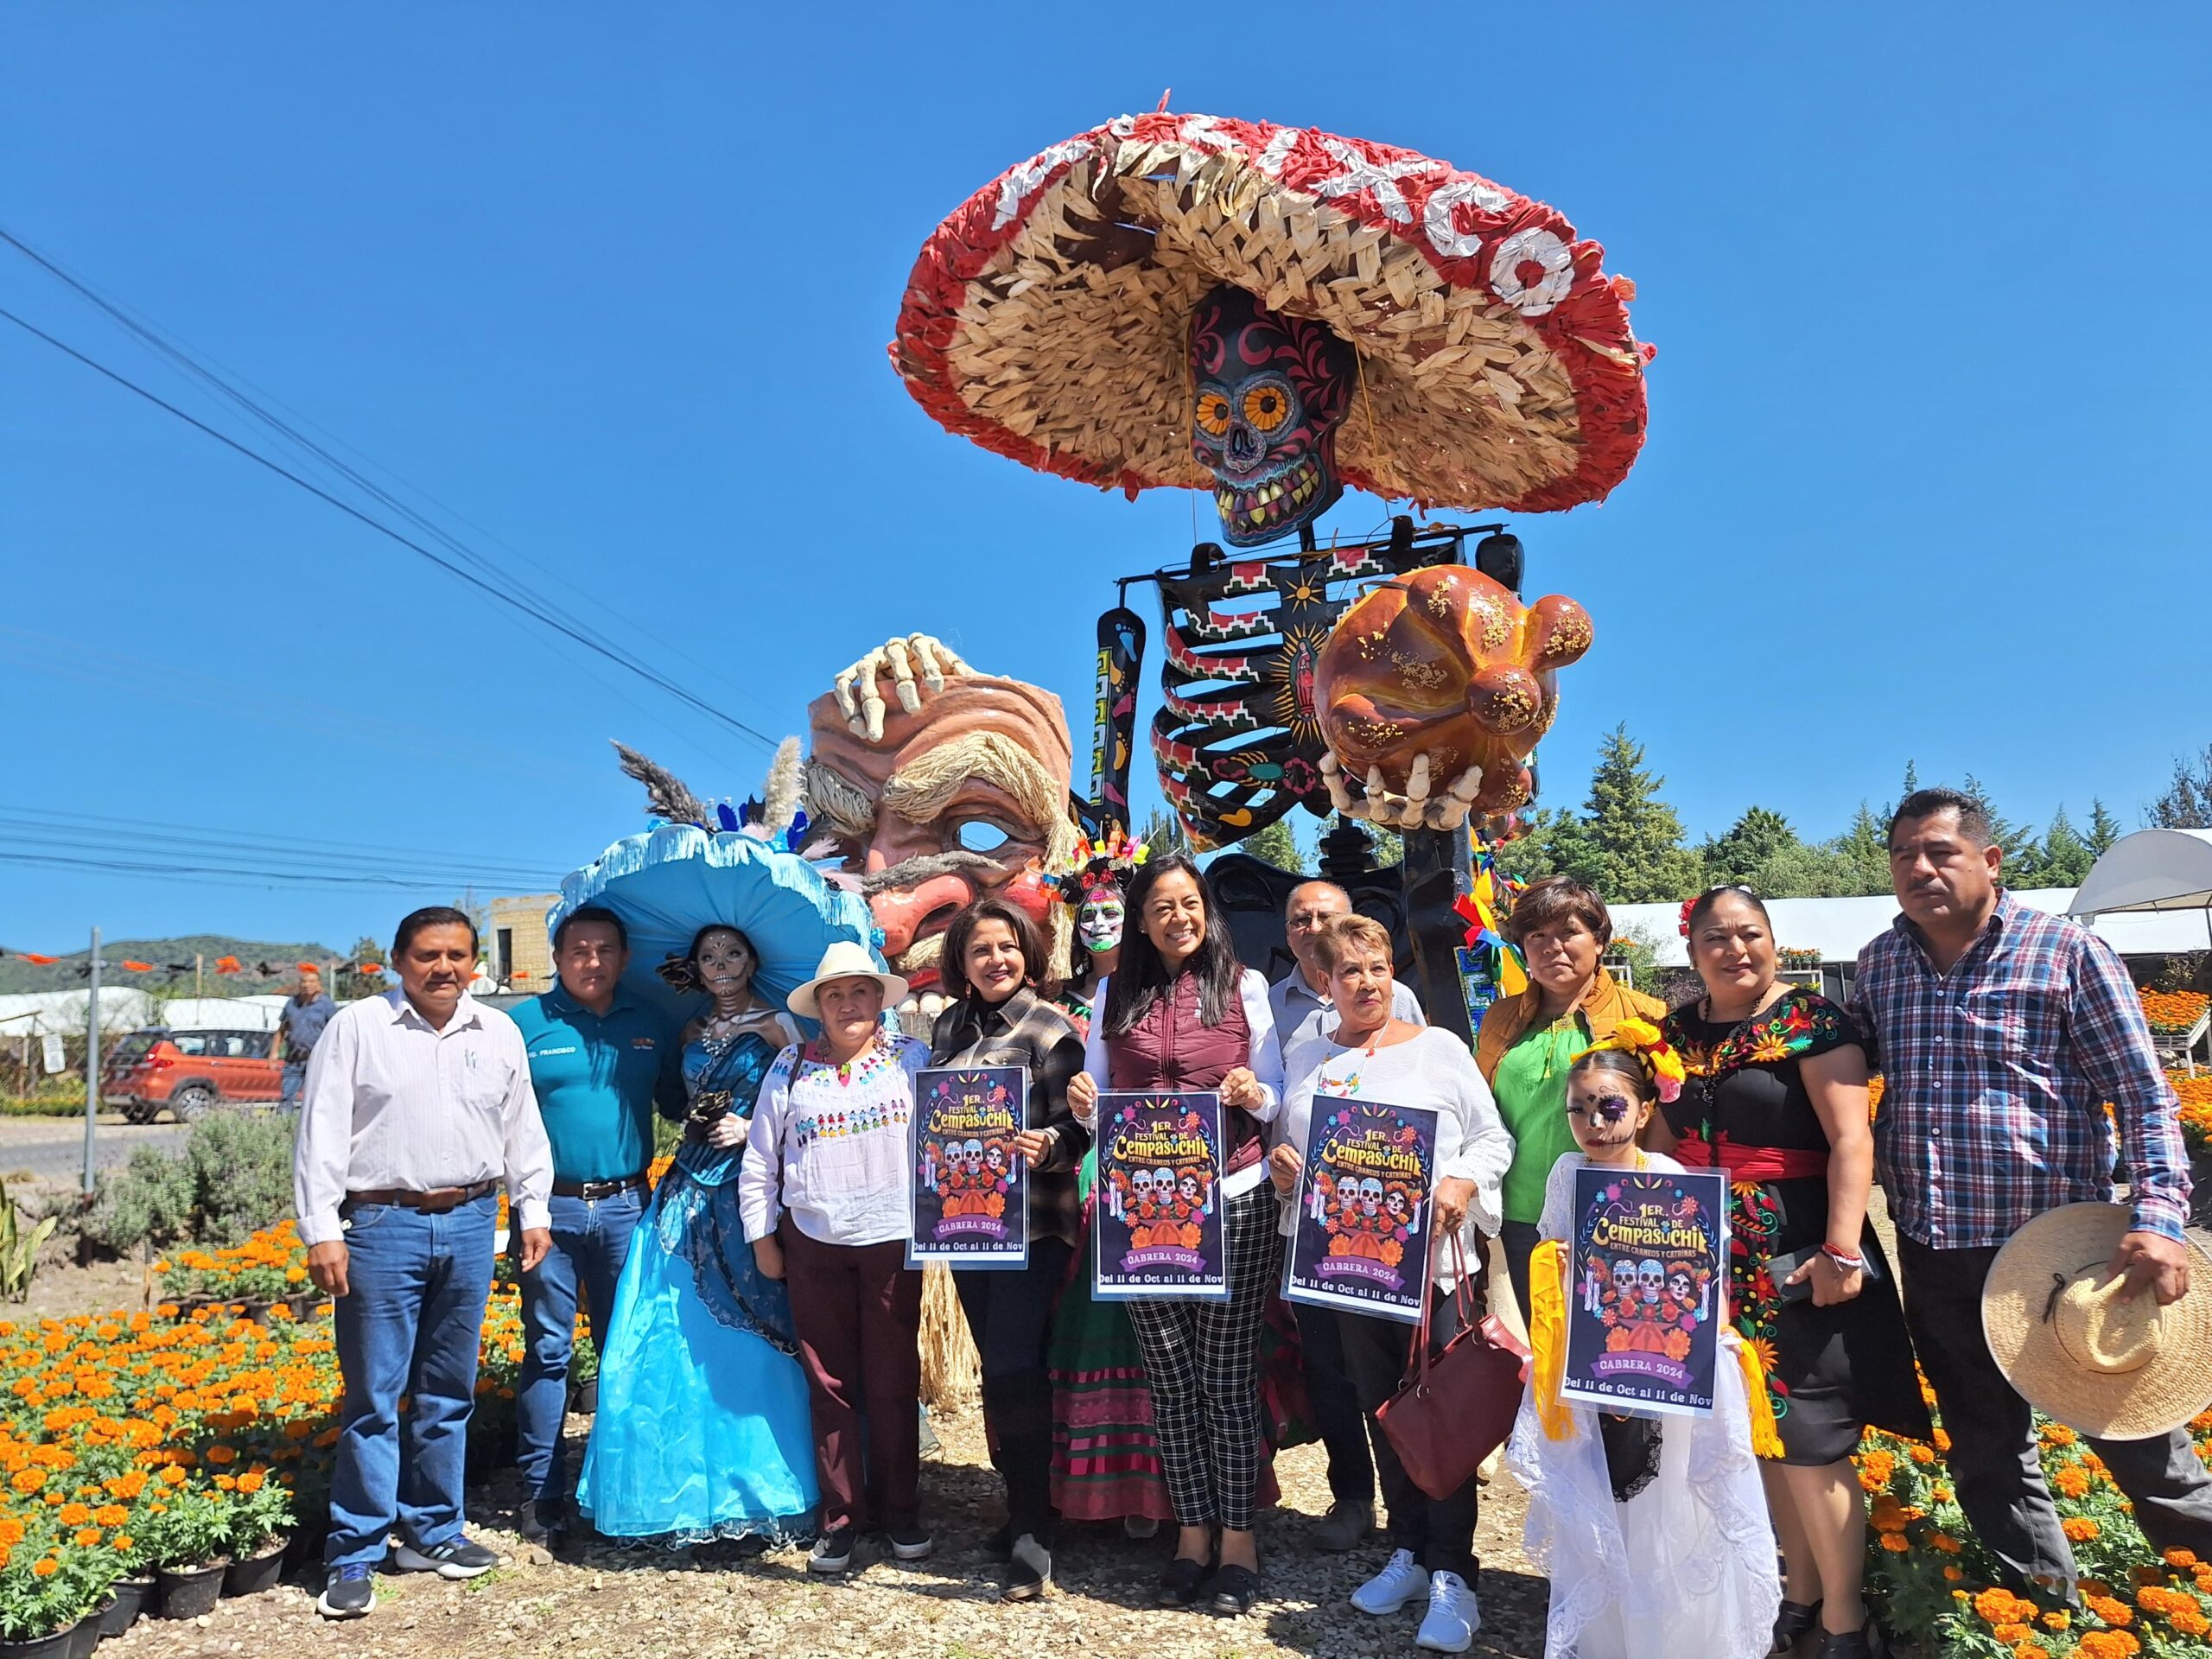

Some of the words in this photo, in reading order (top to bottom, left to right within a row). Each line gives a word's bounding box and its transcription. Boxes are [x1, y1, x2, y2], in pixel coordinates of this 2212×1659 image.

[539, 1046, 576, 1057] FRANCISCO
[1337, 1160, 1354, 1171] ENTRE
[939, 1221, 977, 1233] CABRERA
[982, 1222, 1001, 1232] 2024
[1672, 1219, 1683, 1228] DE
[993, 1242, 1003, 1250] de
[1007, 1242, 1023, 1250] Nov
[1610, 1243, 1630, 1252] ENTRE
[1128, 1252, 1171, 1264] CABRERA
[1175, 1254, 1198, 1263] 2024
[1323, 1262, 1369, 1274] CABRERA
[1372, 1268, 1395, 1282] 2024
[1117, 1274, 1124, 1283] 11
[1129, 1274, 1141, 1283] de
[1144, 1274, 1160, 1283] Oct
[1164, 1274, 1173, 1283] al
[1177, 1274, 1185, 1283] 11
[1189, 1274, 1200, 1283] de
[1205, 1274, 1223, 1283] Nov
[1310, 1279, 1318, 1287] 11
[1322, 1281, 1334, 1290] de
[1338, 1284, 1354, 1294] Oct
[1358, 1288, 1367, 1297] al
[1372, 1290, 1380, 1299] 11
[1384, 1293, 1396, 1301] de
[1401, 1295, 1421, 1306] Nov
[1599, 1360, 1651, 1370] CABRERA
[1656, 1363, 1683, 1379] 2024
[1585, 1380, 1593, 1389] 11
[1599, 1382, 1612, 1392] de
[1617, 1384, 1636, 1395] Oct
[1639, 1389, 1650, 1398] al
[1656, 1389, 1665, 1400] 11
[1670, 1392, 1685, 1402] de
[1689, 1394, 1713, 1406] Nov
